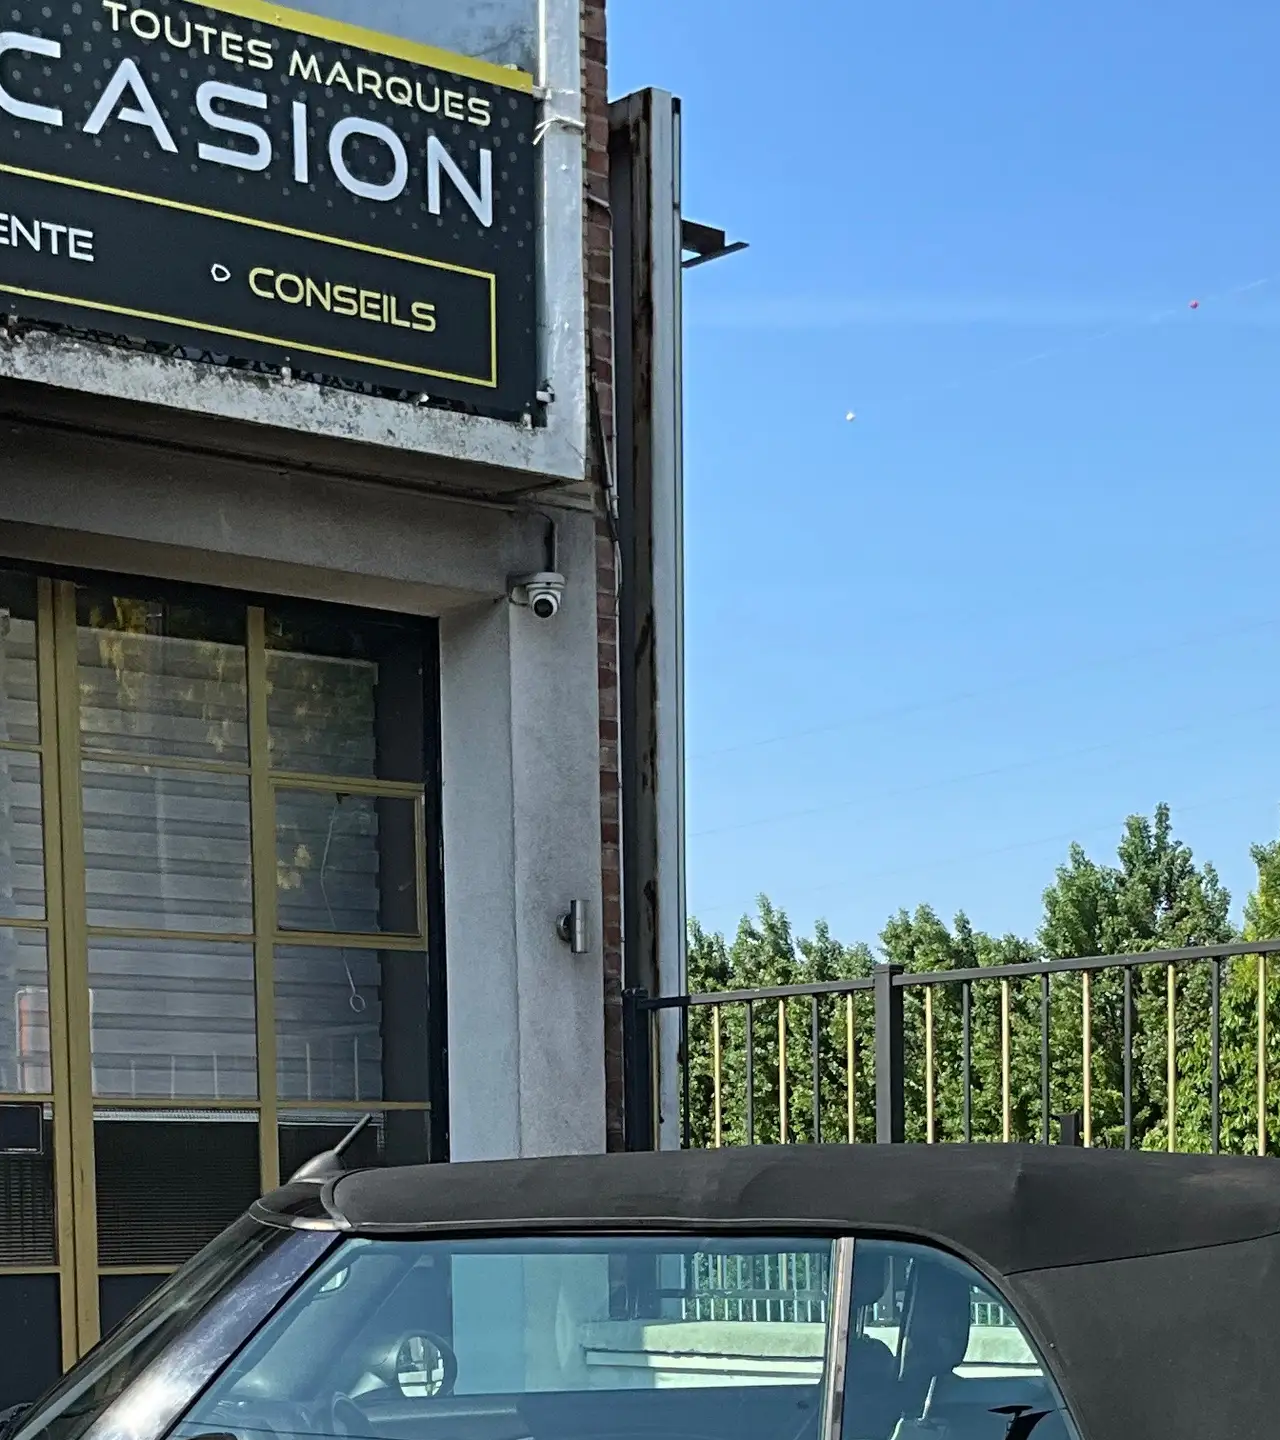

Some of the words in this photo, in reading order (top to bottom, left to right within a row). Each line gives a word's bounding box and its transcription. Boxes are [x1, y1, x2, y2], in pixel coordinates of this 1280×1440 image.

[102, 0, 274, 71] TOUTES
[288, 50, 492, 127] MARQUES
[247, 265, 437, 334] CONSEILS
